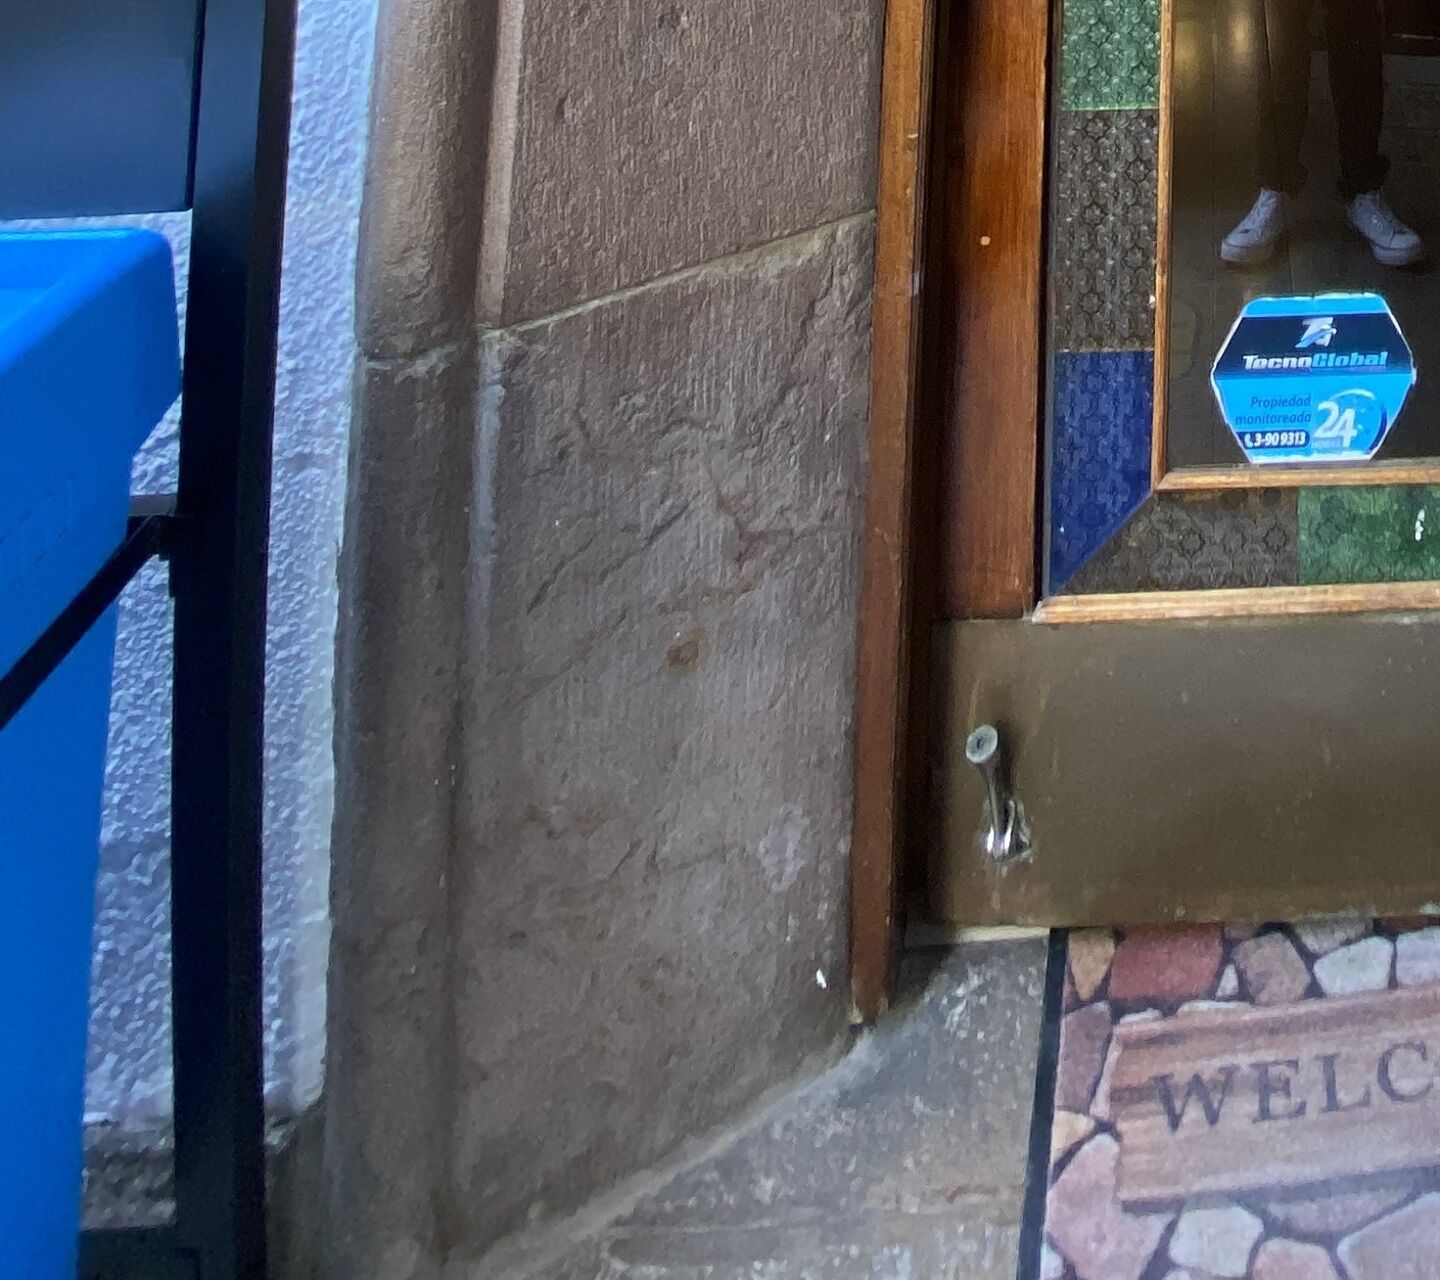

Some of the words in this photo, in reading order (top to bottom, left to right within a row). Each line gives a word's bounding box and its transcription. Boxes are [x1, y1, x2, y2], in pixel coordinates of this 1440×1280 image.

[1243, 351, 1389, 370] TecnoGlobal
[1251, 395, 1311, 409] Propiedad
[1235, 411, 1311, 426] monitoreada
[1313, 401, 1359, 448] 24
